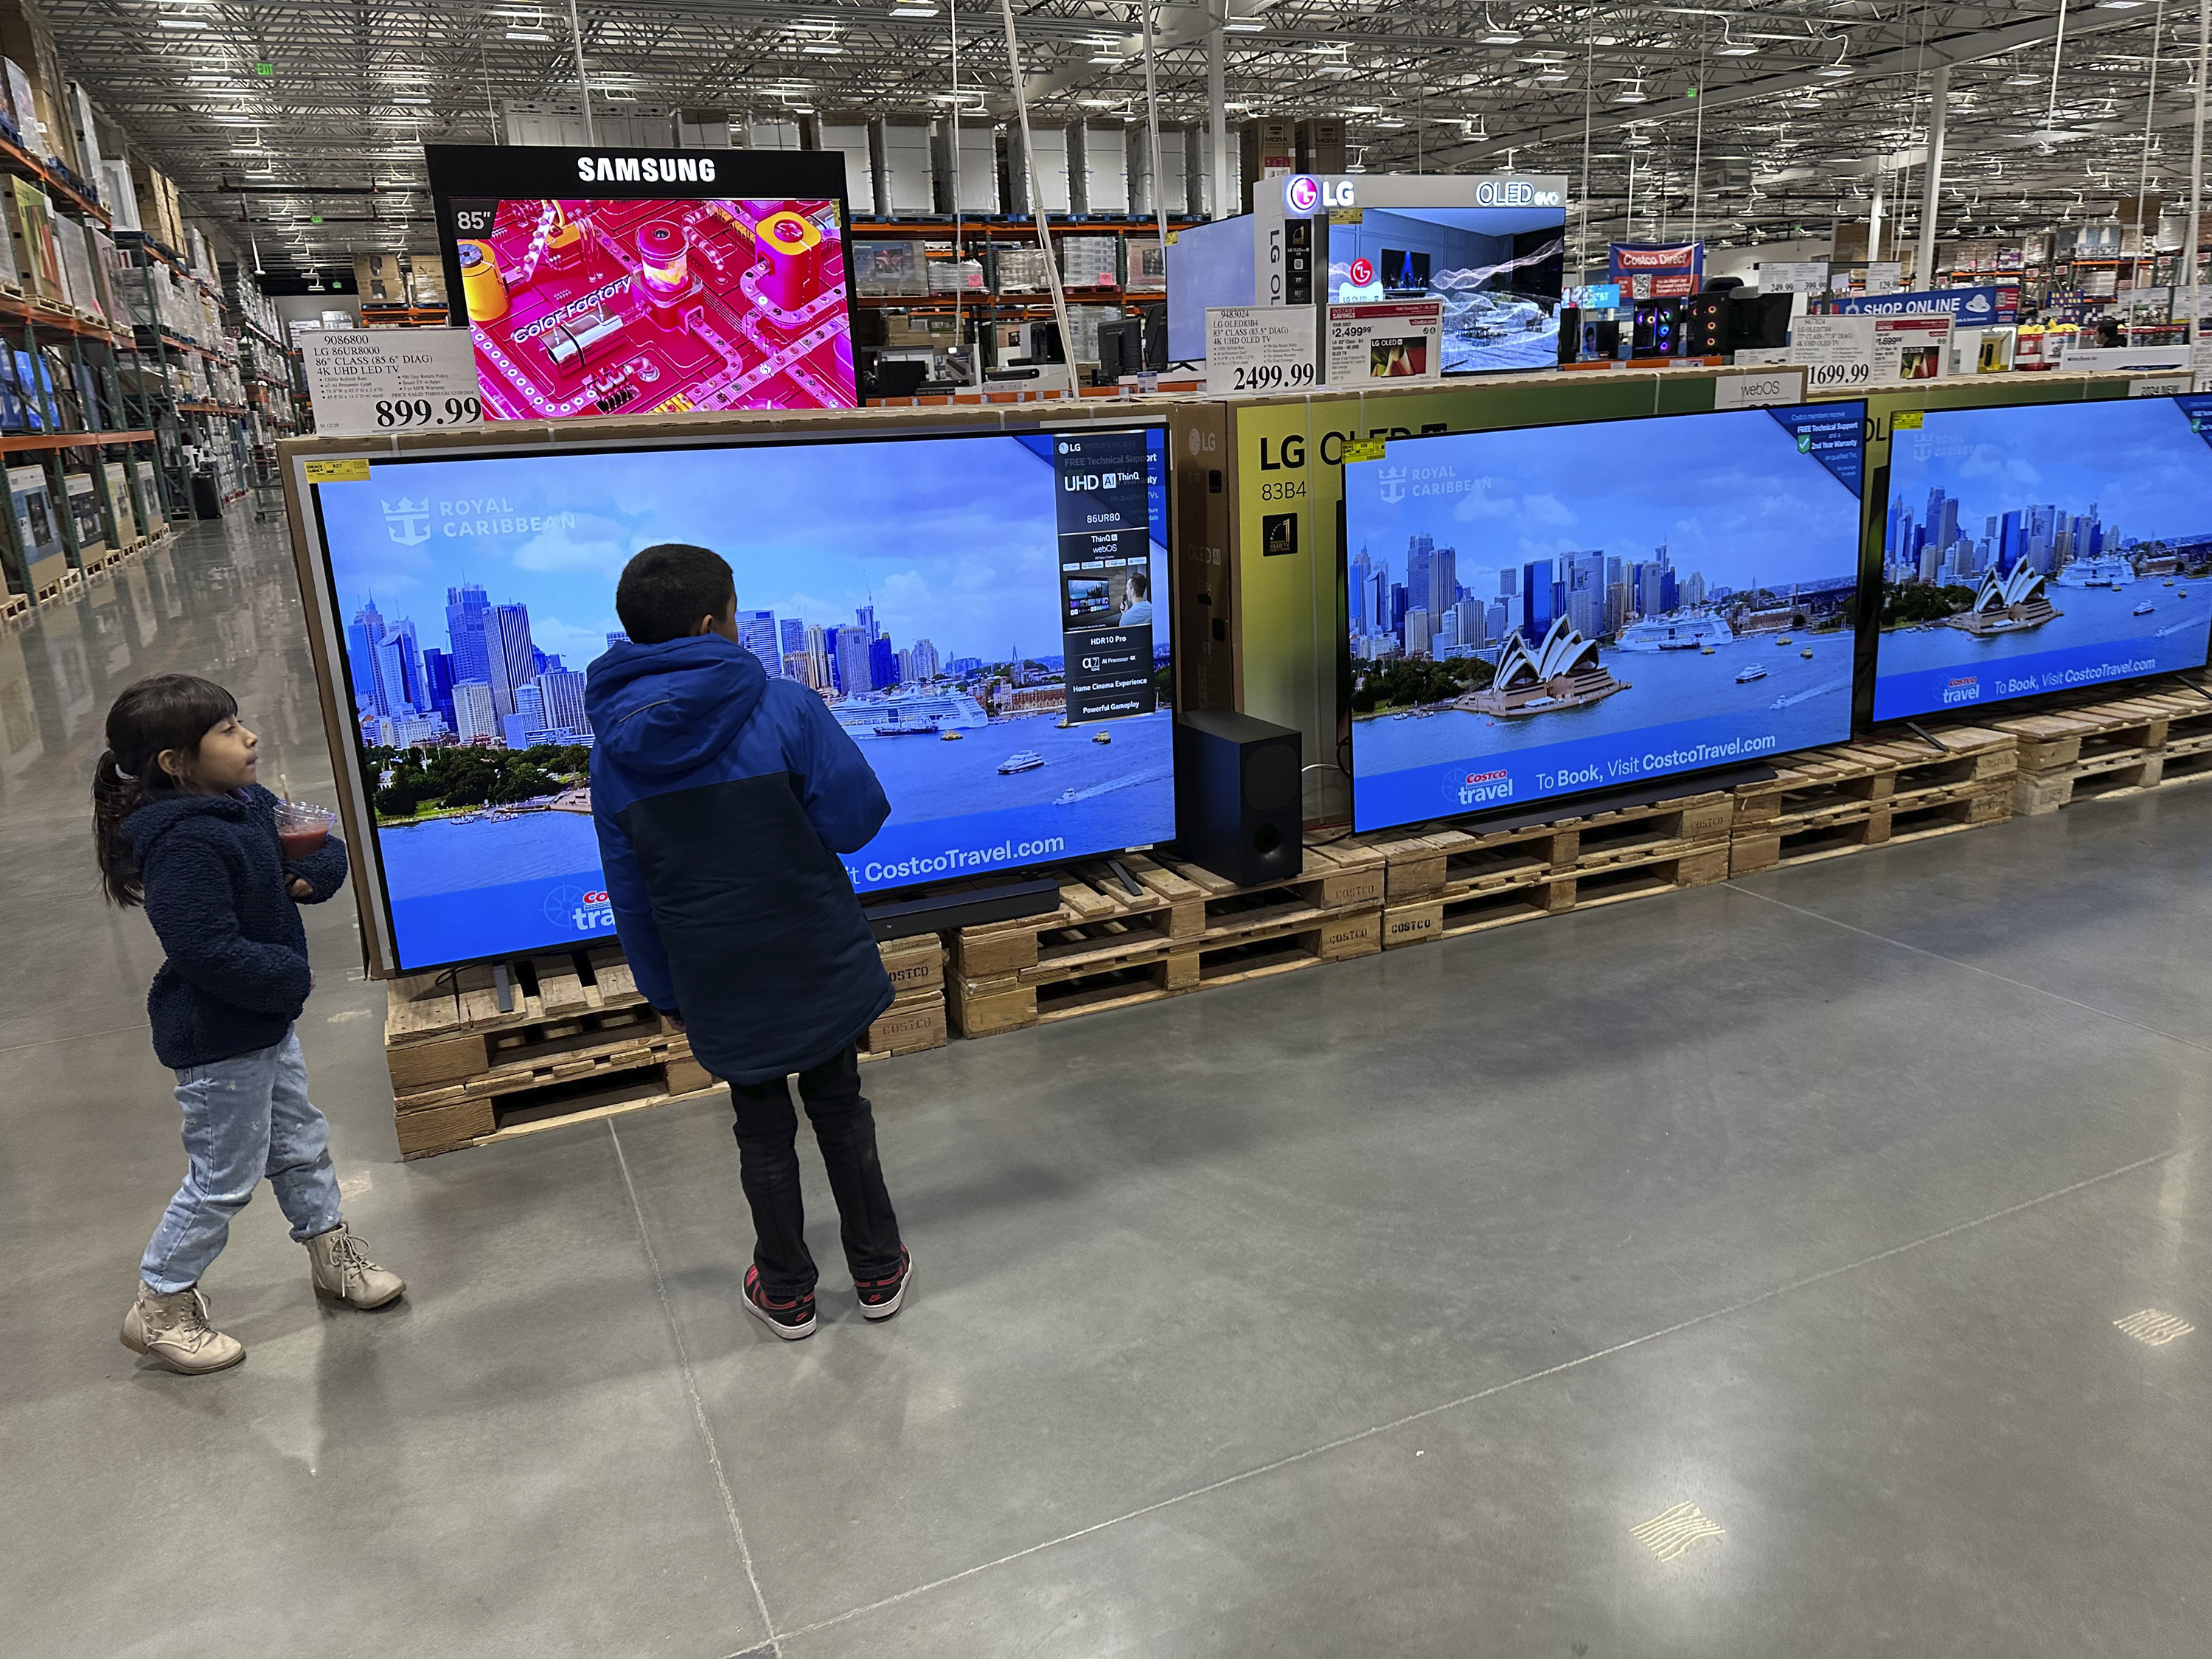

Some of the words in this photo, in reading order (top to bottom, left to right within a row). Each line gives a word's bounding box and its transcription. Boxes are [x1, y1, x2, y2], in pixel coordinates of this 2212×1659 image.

[257, 63, 273, 75] EXIT
[577, 156, 716, 182] SAMSUNG
[1322, 181, 1354, 206] LG
[1475, 181, 1534, 206] OLED
[457, 211, 491, 230] 85"
[1270, 229, 1280, 263] LG
[1623, 254, 1658, 265] Costco
[1658, 253, 1687, 265] Direct
[1804, 282, 1826, 291] 399.99
[512, 307, 563, 343] Color
[566, 275, 632, 318] Factory
[1863, 302, 1903, 315] SHOP
[1905, 297, 1961, 313] ONLINE
[1220, 310, 1249, 319] 9483024
[1224, 319, 1258, 327] OLED83B4
[324, 335, 369, 345] 9086800
[1213, 329, 1223, 337] 83"
[1269, 327, 1289, 335] DIAG)
[1241, 336, 1260, 344] OLED
[314, 347, 329, 355] LG
[332, 347, 380, 355] 86UR8000
[316, 358, 330, 366] 86"
[335, 357, 369, 366] CLASS
[403, 355, 433, 364] DIAG)
[317, 367, 330, 375] 4K
[334, 366, 358, 375] UHD
[361, 366, 383, 374] LED
[385, 366, 399, 374] TV
[1234, 363, 1314, 390] 2499.99
[1809, 364, 1869, 384] 1699.99
[1741, 380, 1781, 396] webOS
[375, 397, 481, 427] 899.99
[1812, 423, 1836, 432] Technical
[1837, 422, 1858, 431] Support
[1069, 443, 1081, 452] LG
[1202, 433, 1216, 451] LG
[1834, 439, 1857, 448] Warranty
[1065, 457, 1085, 467] FREE
[1087, 456, 1124, 466] Technical
[1124, 453, 1158, 464] Support
[1260, 434, 1305, 471] LG
[1412, 465, 1456, 481] ROYAL
[1064, 474, 1099, 492] UHD
[1103, 473, 1116, 489] AI
[1117, 471, 1140, 481] ThinQ
[1413, 478, 1492, 497] CARIBBEAN
[1262, 481, 1307, 501] 83B4
[439, 497, 514, 517] ROYAL
[442, 512, 577, 538] CARIBBEAN
[1086, 512, 1121, 524] 86UR80
[1091, 534, 1111, 543] ThinQ
[1092, 544, 1118, 554] webOS
[1188, 544, 1211, 564] OLED
[1091, 636, 1114, 645] HDR10
[1092, 682, 1114, 690] Cinema
[1115, 678, 1147, 689] Experience
[1949, 676, 1977, 687] COSTCO
[1994, 681, 2006, 695] To
[2008, 675, 2039, 692] Book,
[2042, 671, 2064, 686] Visit
[2065, 658, 2156, 684] CostcoTravel.com
[1943, 684, 1980, 704] travel
[1082, 703, 1110, 714] Powerful
[1110, 700, 1140, 711] Gameplay
[1536, 773, 1554, 791] To
[1557, 763, 1604, 787] Book,
[1607, 759, 1640, 777] Visit
[1642, 734, 1775, 771] CostcoTravel.com
[1465, 768, 1508, 785] COSTCO
[1458, 777, 1514, 805] travel
[1690, 816, 1723, 830] COSTCO
[864, 835, 1065, 883] CostcoTravel.com
[1336, 885, 1374, 900] COSTCO
[572, 908, 616, 931] tra
[1391, 919, 1431, 934] COSTCO
[1329, 928, 1368, 945] COSTCO
[888, 966, 929, 982] OSTCO
[883, 1018, 931, 1034] COSTCO
